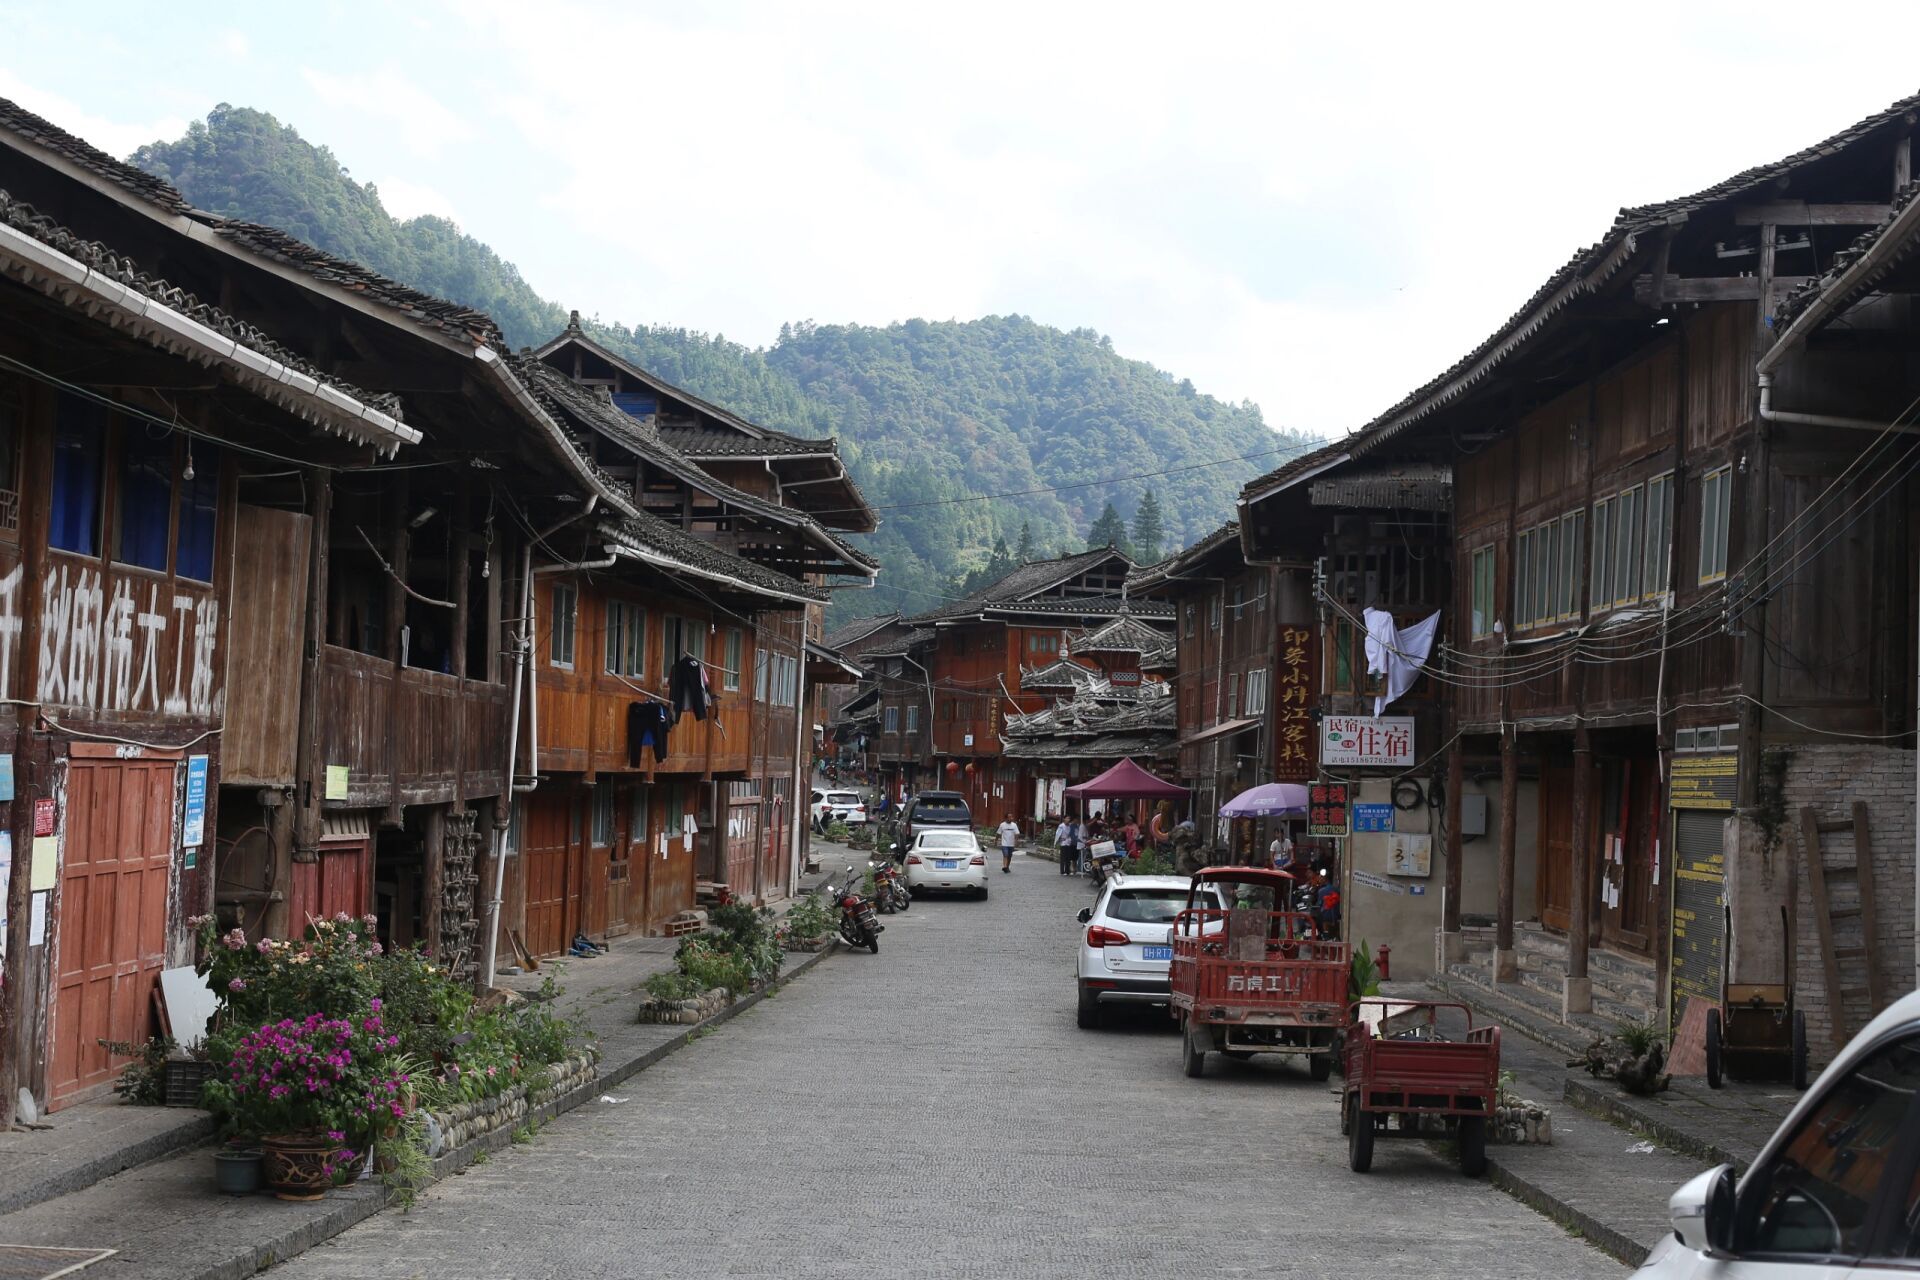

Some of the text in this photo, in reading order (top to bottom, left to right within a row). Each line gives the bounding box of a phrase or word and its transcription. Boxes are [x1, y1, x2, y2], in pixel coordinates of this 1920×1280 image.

[1281, 628, 1309, 761] 印象小丹江客栈
[1329, 718, 1358, 732] 民宿
[1356, 725, 1409, 757] 住宿
[1395, 848, 1404, 863] 3
